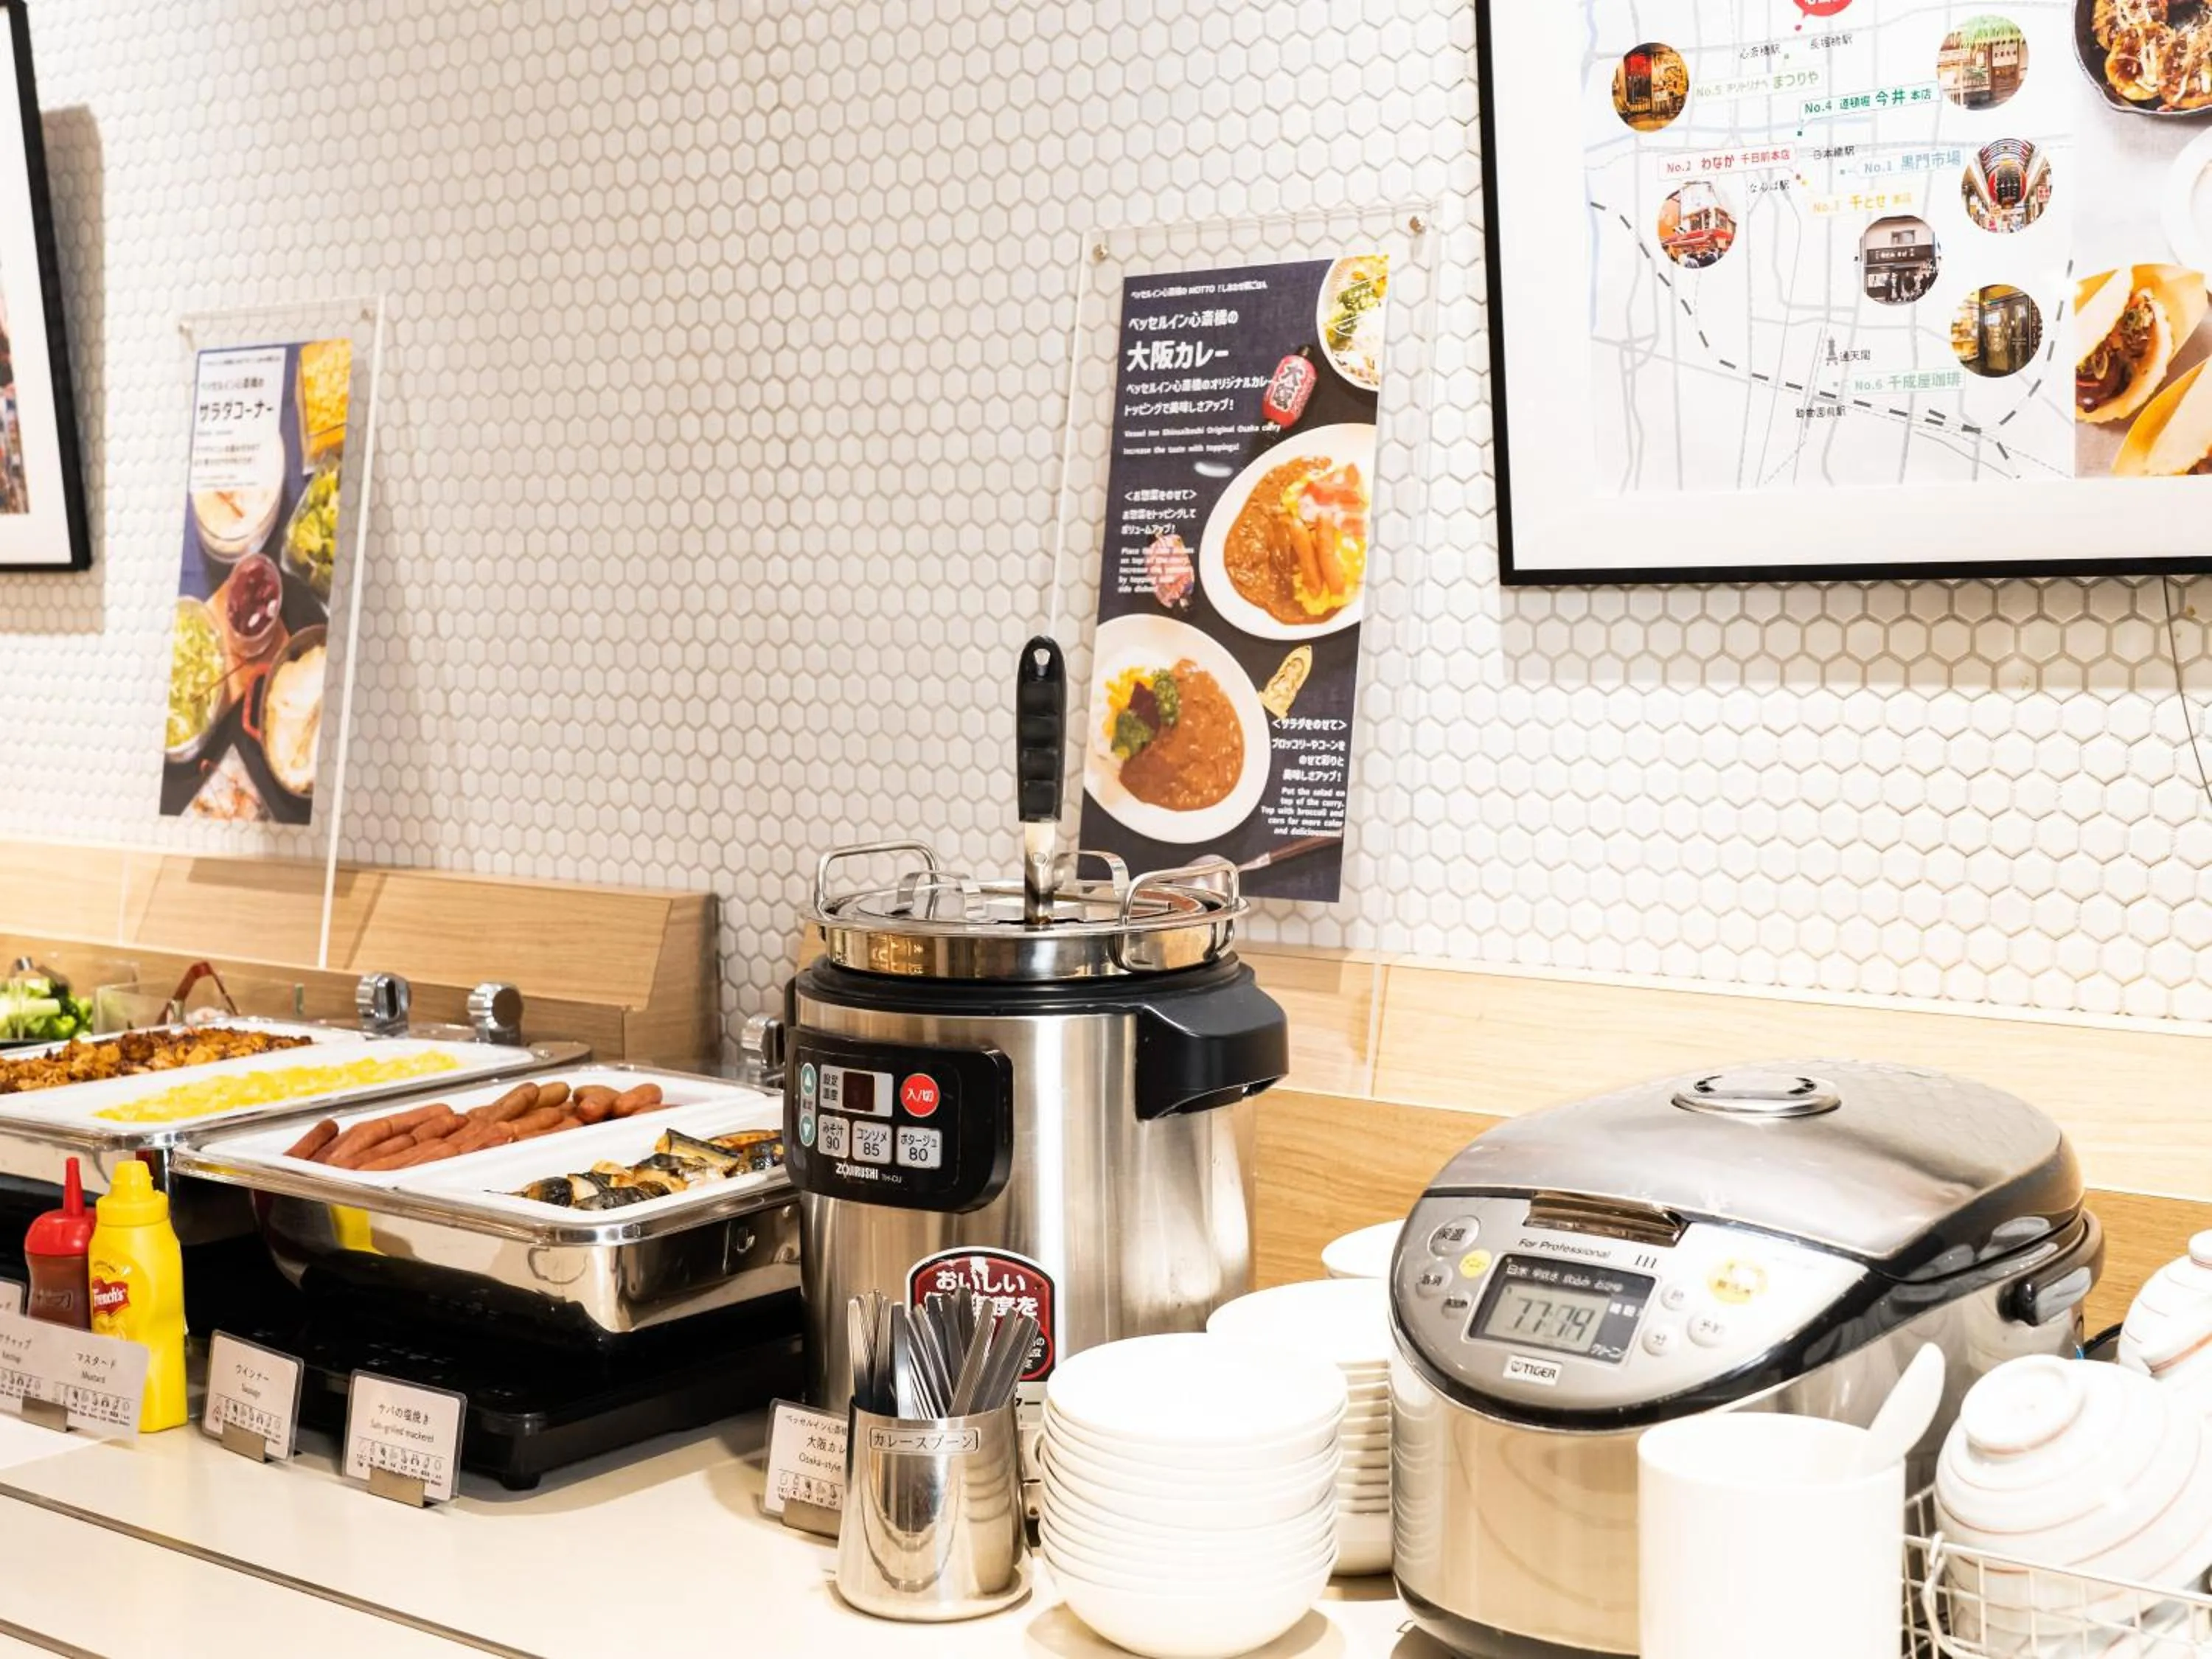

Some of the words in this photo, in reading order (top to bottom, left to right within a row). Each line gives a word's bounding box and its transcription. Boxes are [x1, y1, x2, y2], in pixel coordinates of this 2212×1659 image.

[1773, 72, 1819, 88] まつりや
[1805, 101, 1832, 114] No.4
[1875, 88, 1906, 105] 今井
[1910, 88, 1932, 100] 本店
[1701, 155, 1735, 170] わなか
[1741, 150, 1790, 164] 千日前本店
[1864, 160, 1892, 174] No.1
[1901, 150, 1961, 170] 黒門市場
[1850, 194, 1887, 210] 千とせ
[1126, 340, 1229, 372] 大阪カレー
[1855, 378, 1882, 390] No.6
[1888, 372, 1961, 391] 千成屋珈琲
[199, 399, 274, 422] サラダコーナー
[1281, 787, 1295, 795] Put
[1298, 787, 1310, 796] the
[1313, 788, 1333, 797] salad
[1280, 798, 1293, 806] top
[1307, 799, 1319, 807] the
[1261, 806, 1275, 815] Top
[1278, 807, 1294, 815] with
[1329, 809, 1344, 818] and
[1287, 817, 1298, 825] for
[822, 1121, 844, 1137] みそ汁
[856, 1128, 888, 1142] コンソメ
[826, 1135, 841, 1150] 90
[900, 1133, 938, 1148] ポタージュ
[863, 1142, 880, 1157] 85
[908, 1147, 928, 1161] 80
[1518, 1238, 1537, 1248] For
[1540, 1241, 1612, 1258] Professional
[936, 1270, 1026, 1293] おいしい
[0, 1333, 32, 1350] チャップ
[76, 1352, 116, 1369] マスタード
[1523, 1364, 1557, 1379] TIGER
[378, 1404, 429, 1425] サバの塩焼き
[873, 1432, 974, 1450] カレースプーン
